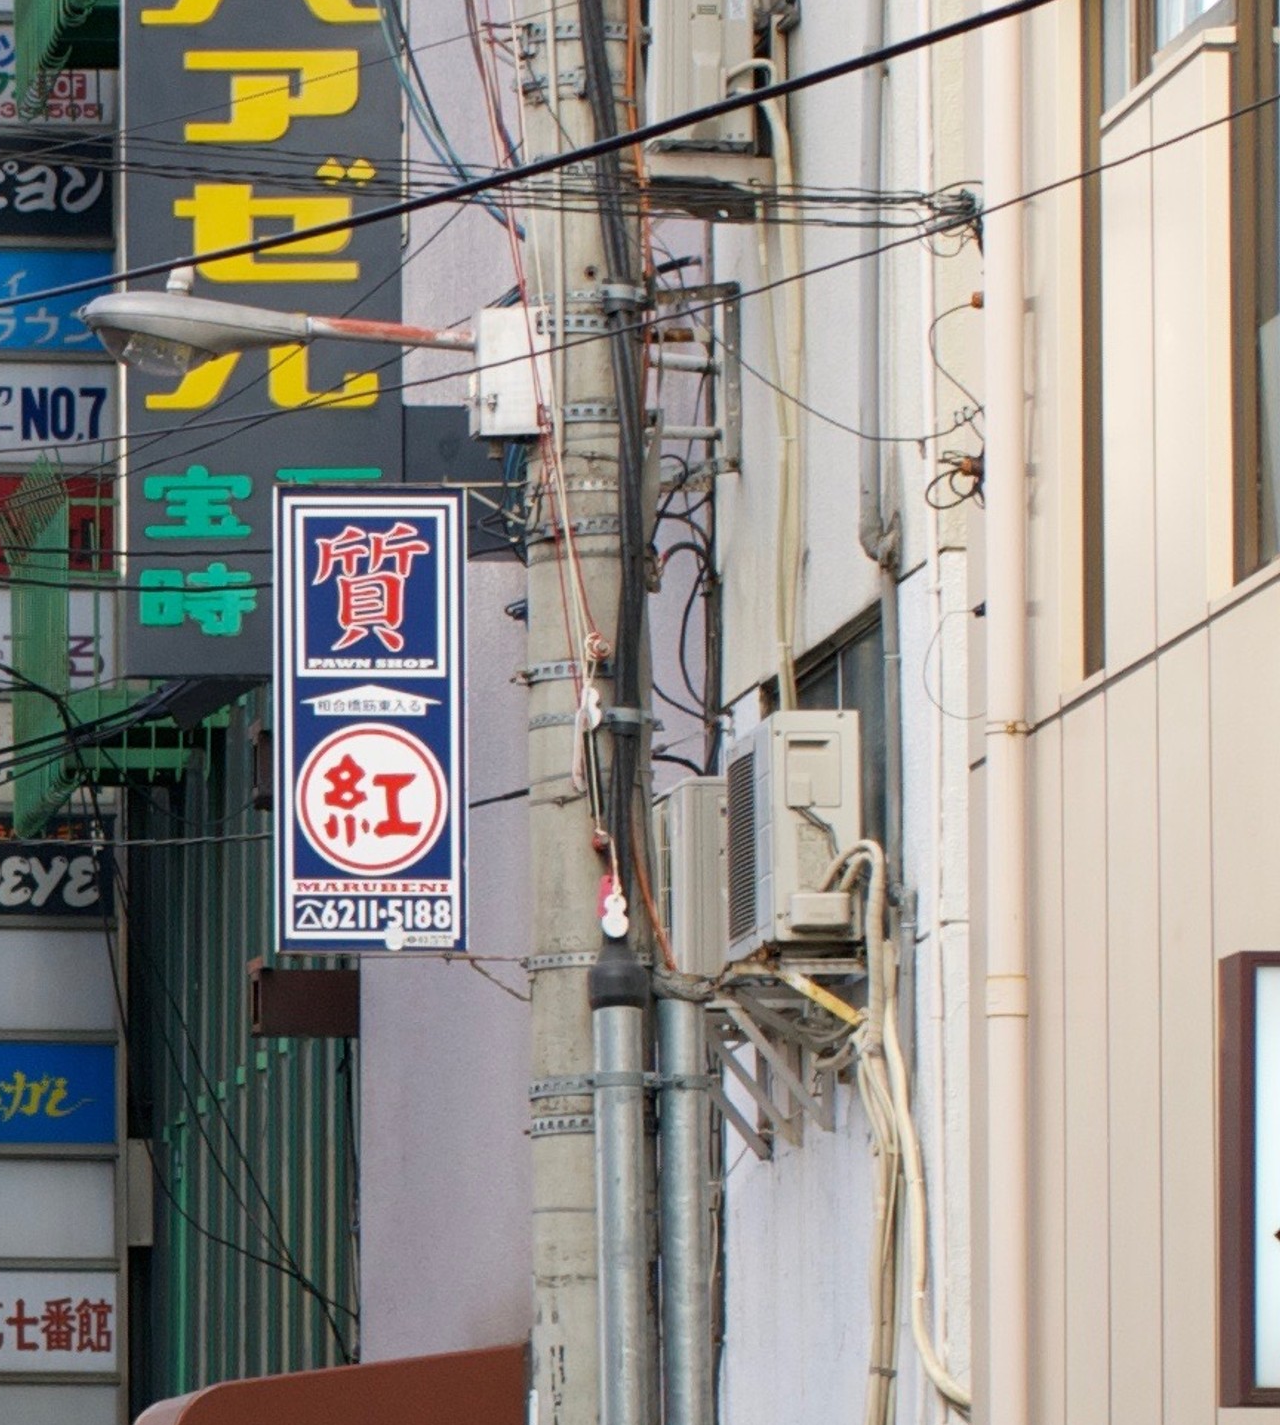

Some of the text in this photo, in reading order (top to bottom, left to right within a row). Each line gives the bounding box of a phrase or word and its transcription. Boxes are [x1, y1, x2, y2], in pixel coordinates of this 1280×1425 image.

[312, 522, 430, 652] 質
[308, 658, 435, 670] PAWN SHOP
[323, 754, 422, 847] 紅
[296, 881, 450, 893] MARUBENI
[6, 1297, 113, 1354] 七番館
